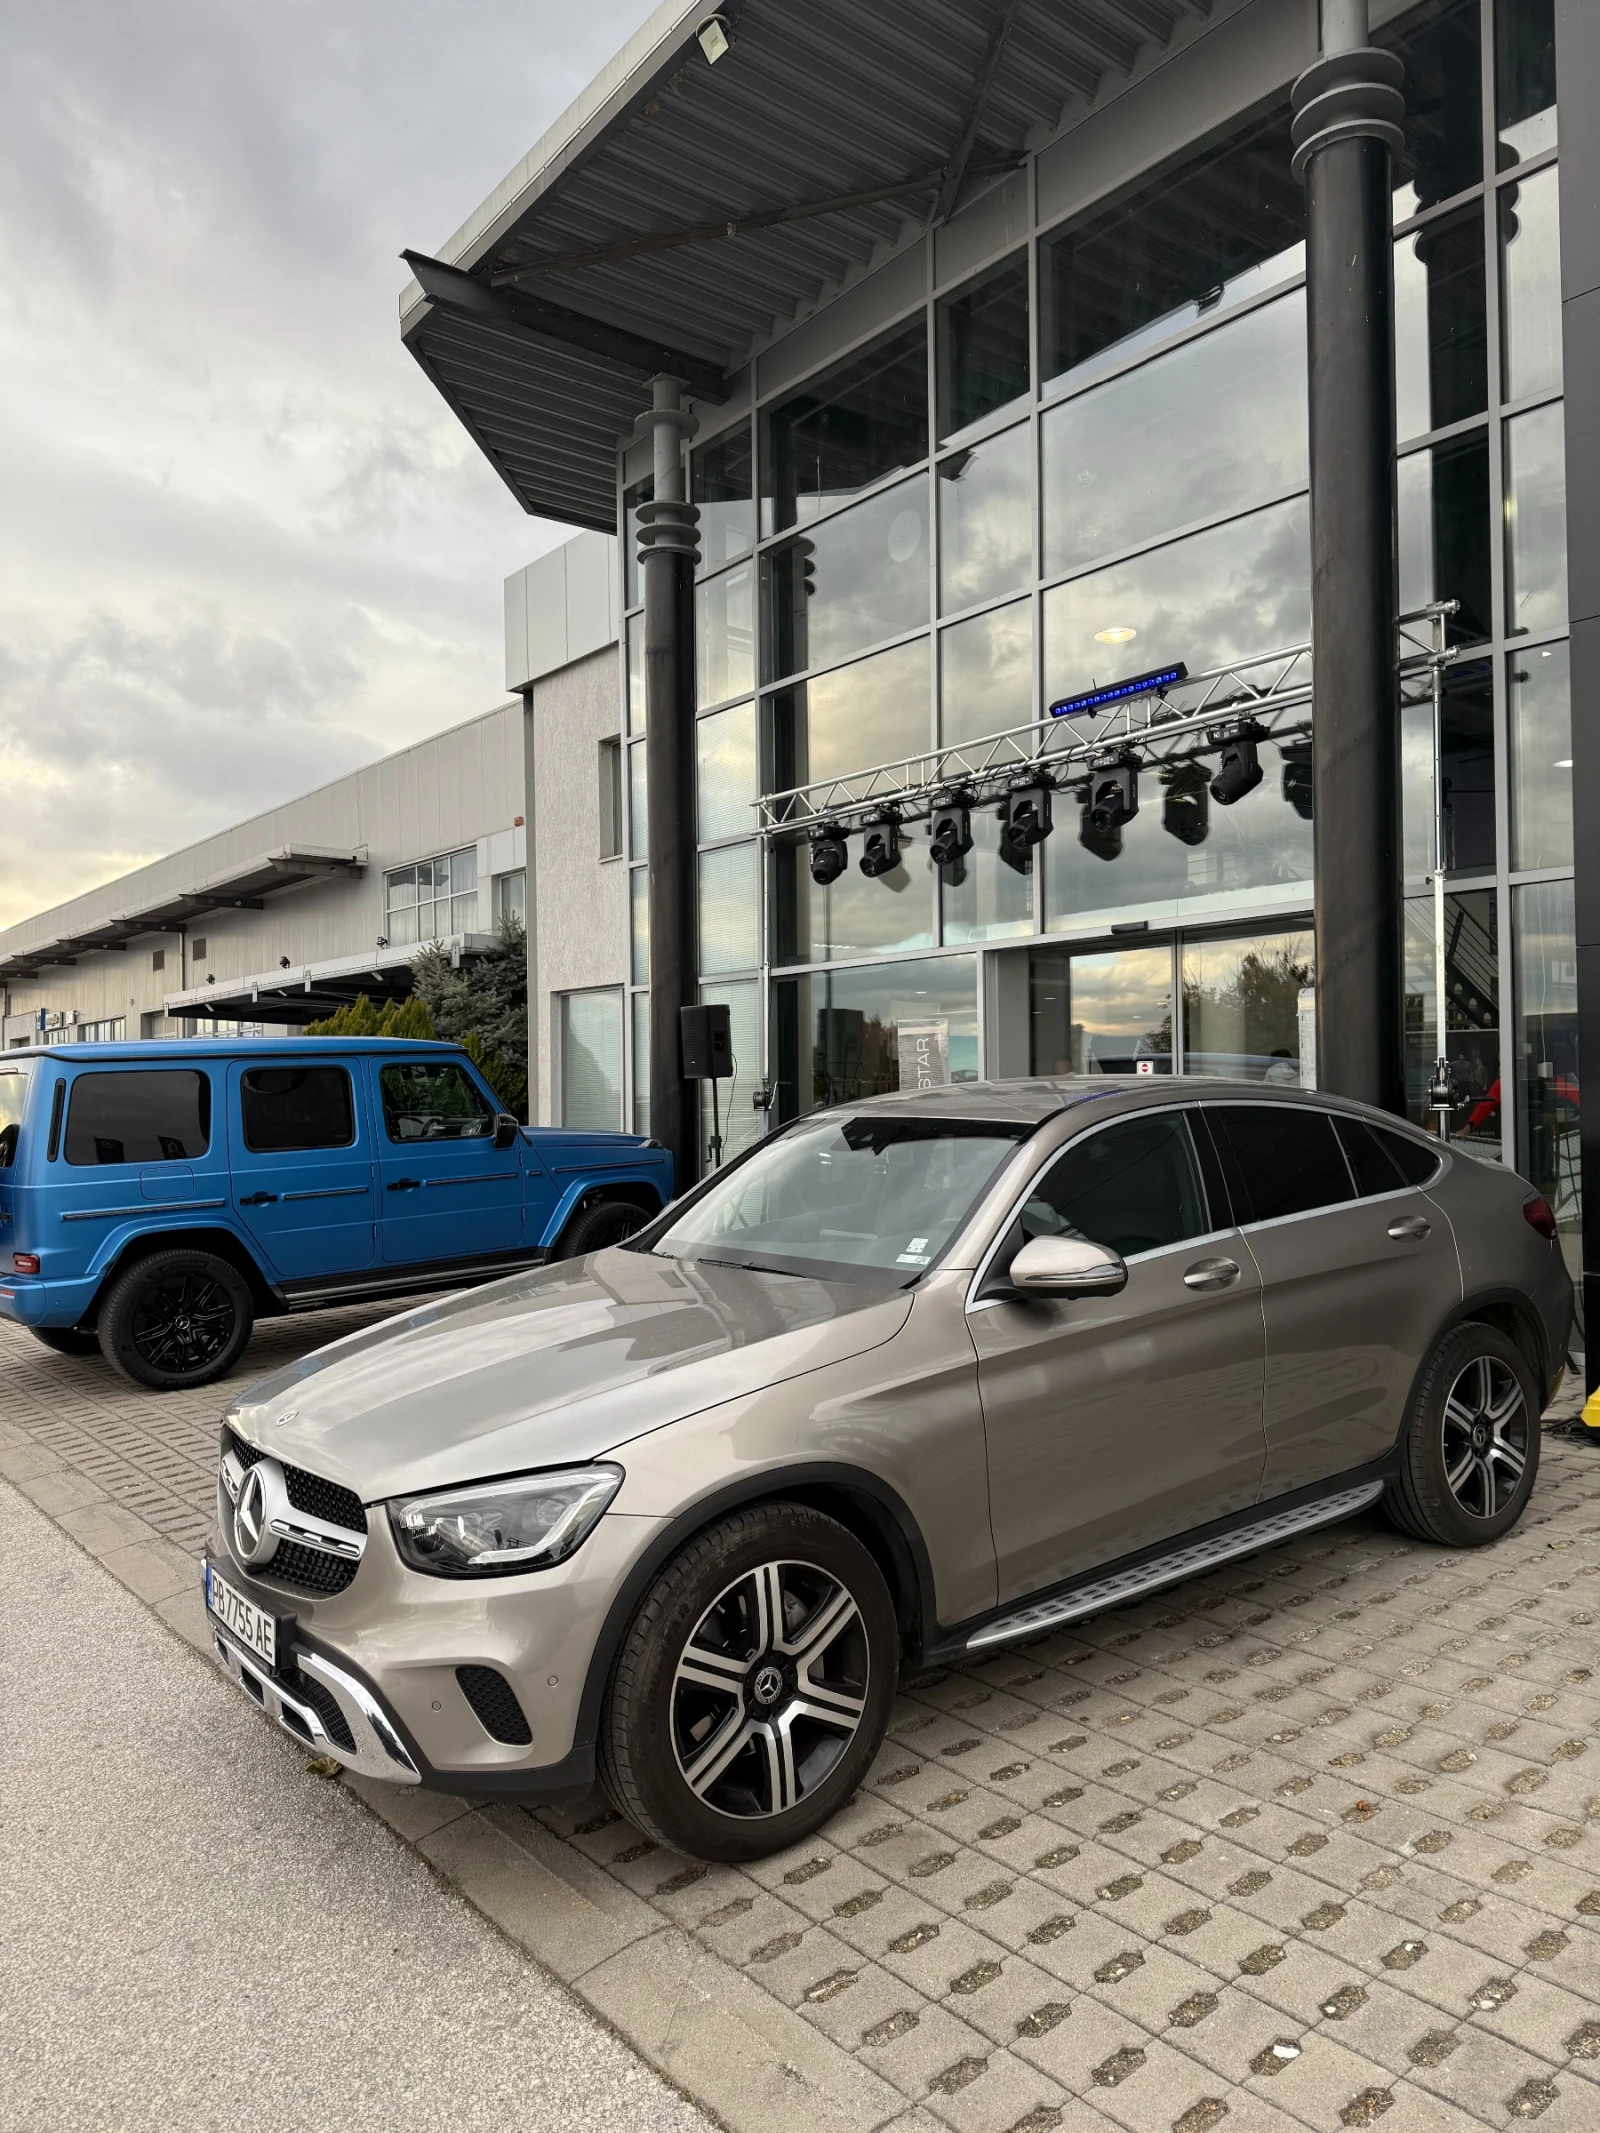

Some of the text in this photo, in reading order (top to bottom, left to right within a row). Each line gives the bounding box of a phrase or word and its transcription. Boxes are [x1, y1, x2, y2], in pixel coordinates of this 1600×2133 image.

[916, 1037, 931, 1089] STAR
[212, 1574, 225, 1616] PB
[226, 1587, 253, 1642] 7755
[255, 1614, 273, 1660] AE
